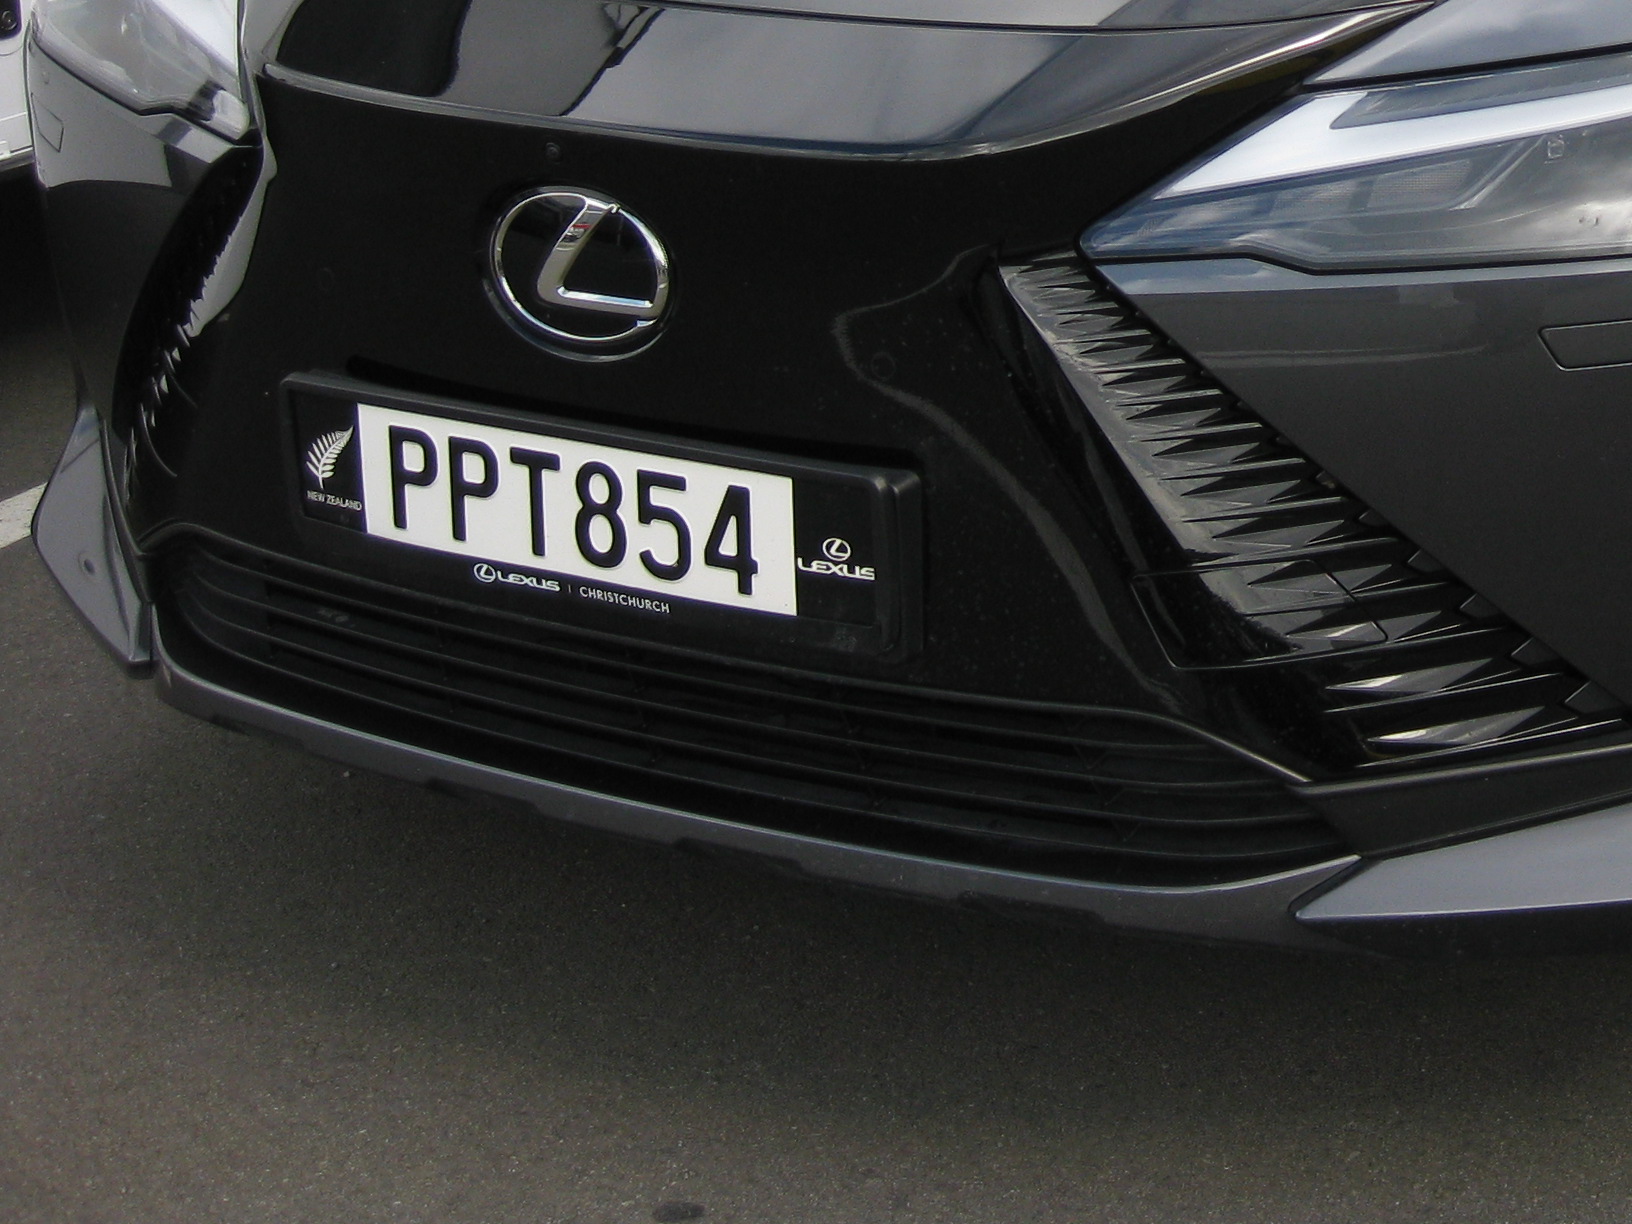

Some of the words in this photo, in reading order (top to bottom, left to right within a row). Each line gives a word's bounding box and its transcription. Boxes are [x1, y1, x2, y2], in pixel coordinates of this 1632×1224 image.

[306, 489, 326, 504] NEW
[326, 491, 363, 511] ZEALAND
[387, 424, 759, 596] PPT854
[797, 557, 876, 581] LEXUS
[496, 570, 561, 592] LEXUS
[579, 586, 671, 614] CHRISTCHURCH
